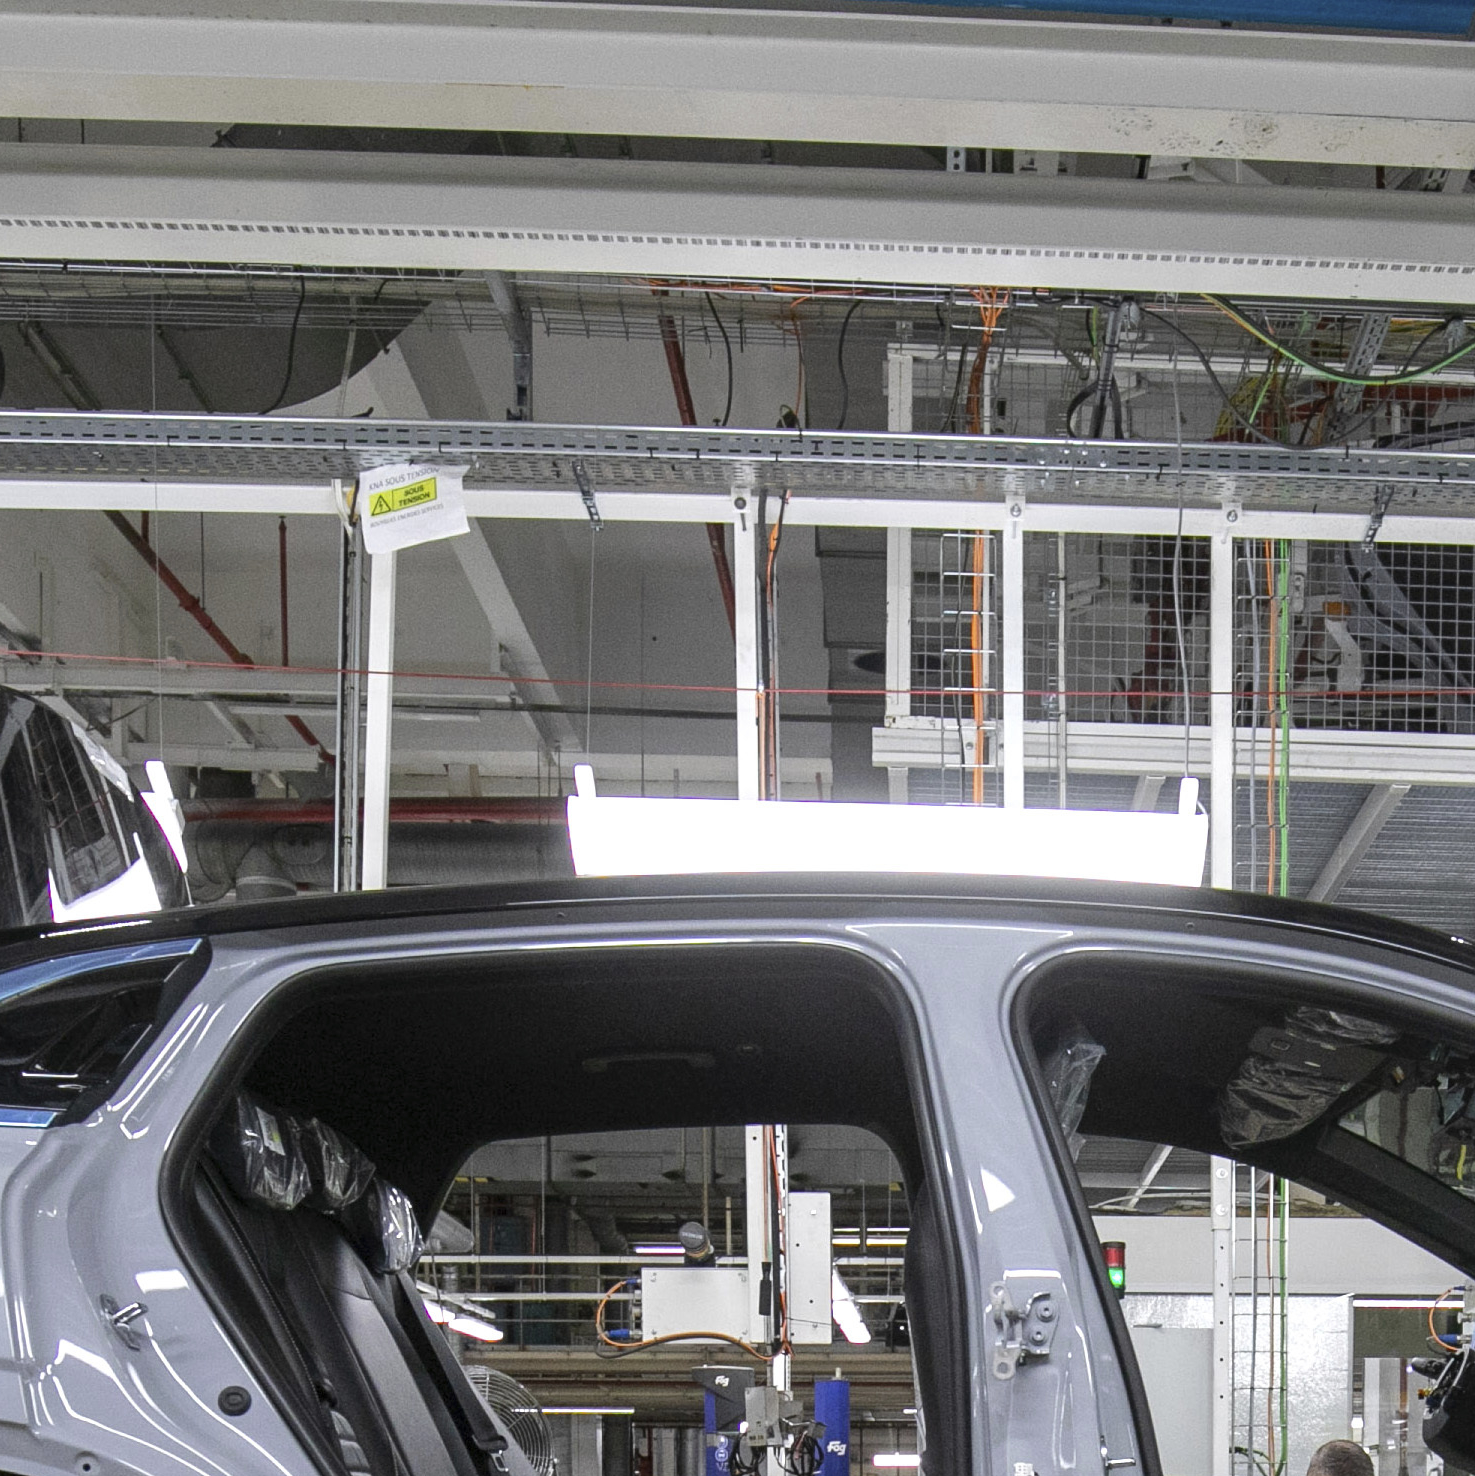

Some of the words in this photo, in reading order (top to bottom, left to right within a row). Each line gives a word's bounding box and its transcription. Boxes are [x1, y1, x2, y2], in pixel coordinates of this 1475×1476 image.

[385, 474, 405, 486] SOUS
[407, 467, 441, 481] TENSION
[403, 484, 424, 497] SOUS
[398, 491, 430, 507] TENSION
[826, 1441, 847, 1455] Fog
